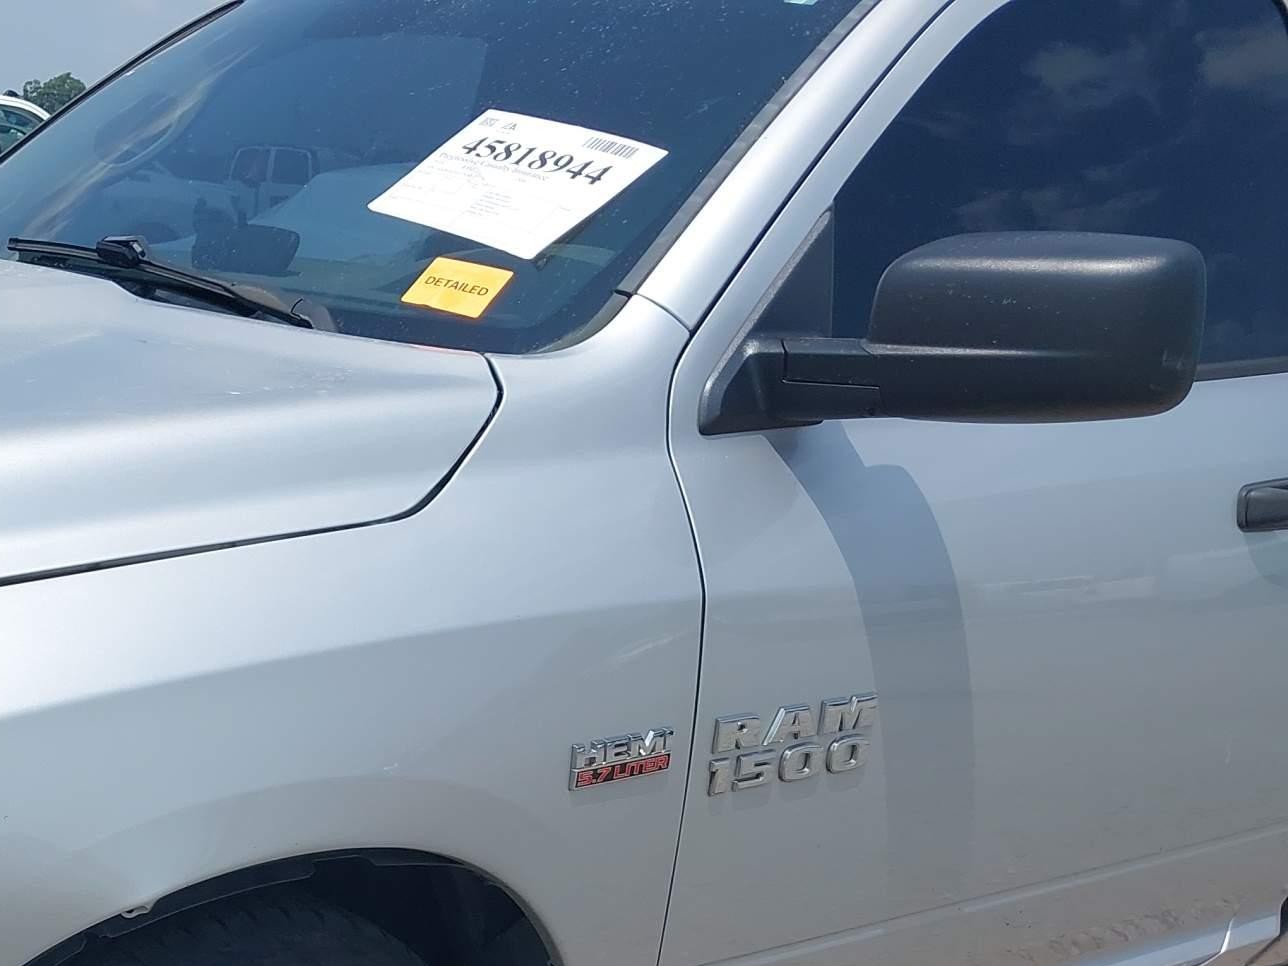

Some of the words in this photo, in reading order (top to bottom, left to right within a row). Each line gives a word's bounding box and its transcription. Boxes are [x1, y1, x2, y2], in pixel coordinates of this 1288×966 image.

[462, 136, 614, 185] 45818944
[424, 275, 489, 296] DETAILED
[712, 691, 878, 753] RAM
[570, 726, 674, 770] HEMI
[576, 767, 612, 788] 5.7
[613, 754, 669, 779] LITER
[707, 732, 872, 797] 1500
